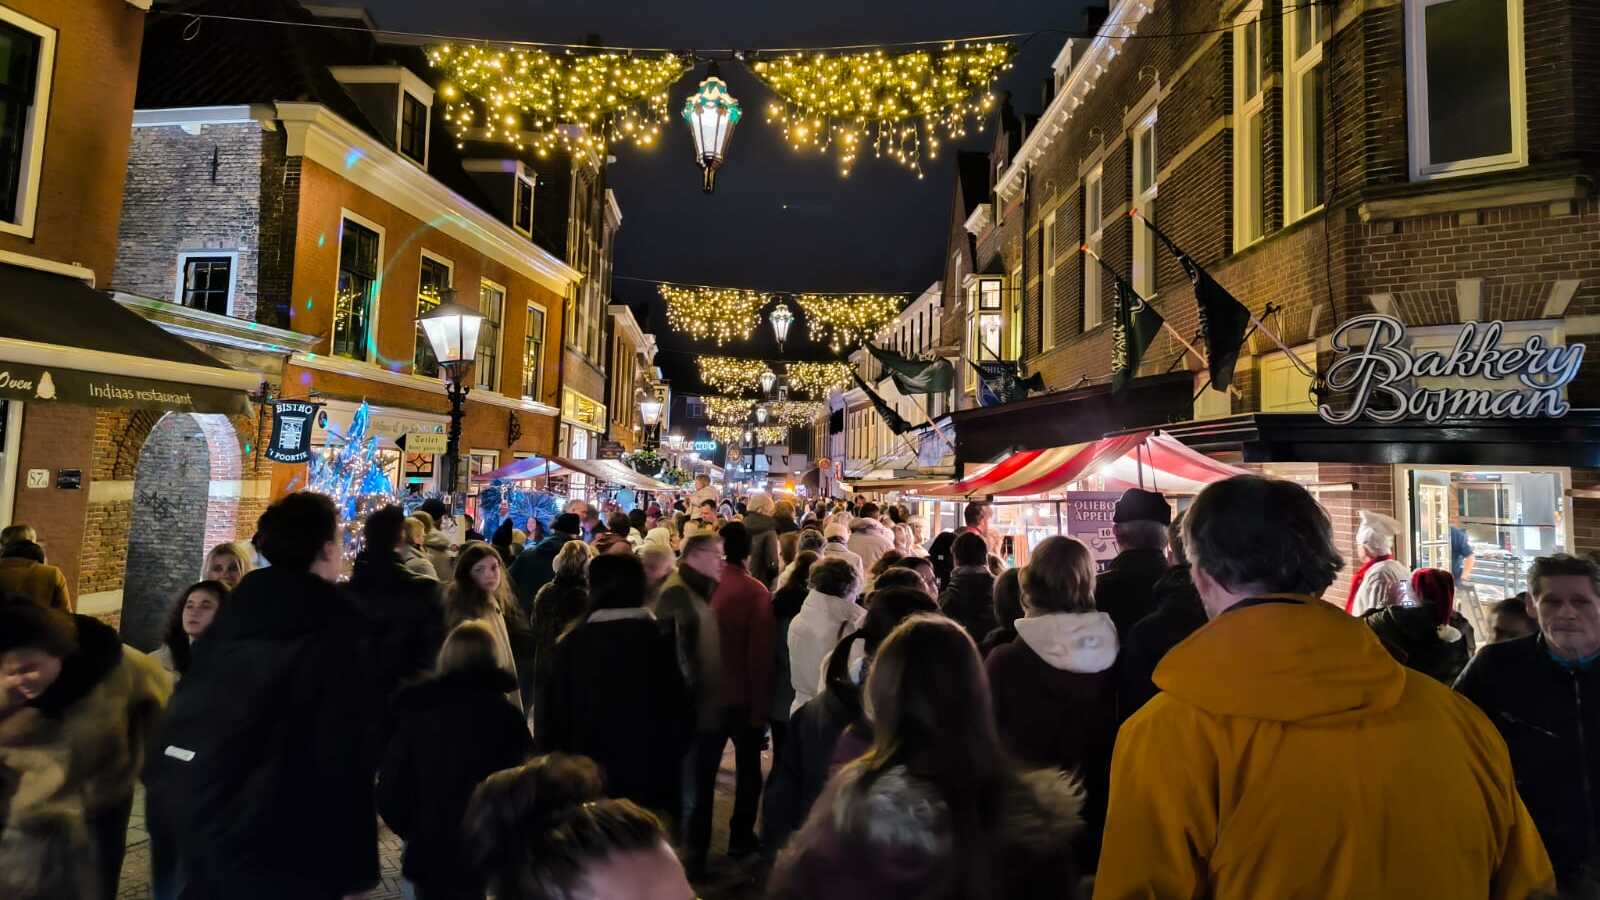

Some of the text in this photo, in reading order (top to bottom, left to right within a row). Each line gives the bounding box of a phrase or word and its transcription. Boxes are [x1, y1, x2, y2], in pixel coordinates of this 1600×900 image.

[0, 371, 33, 390] Oven
[89, 383, 193, 405] Indiaas restaurant
[276, 403, 313, 415] BISTRO
